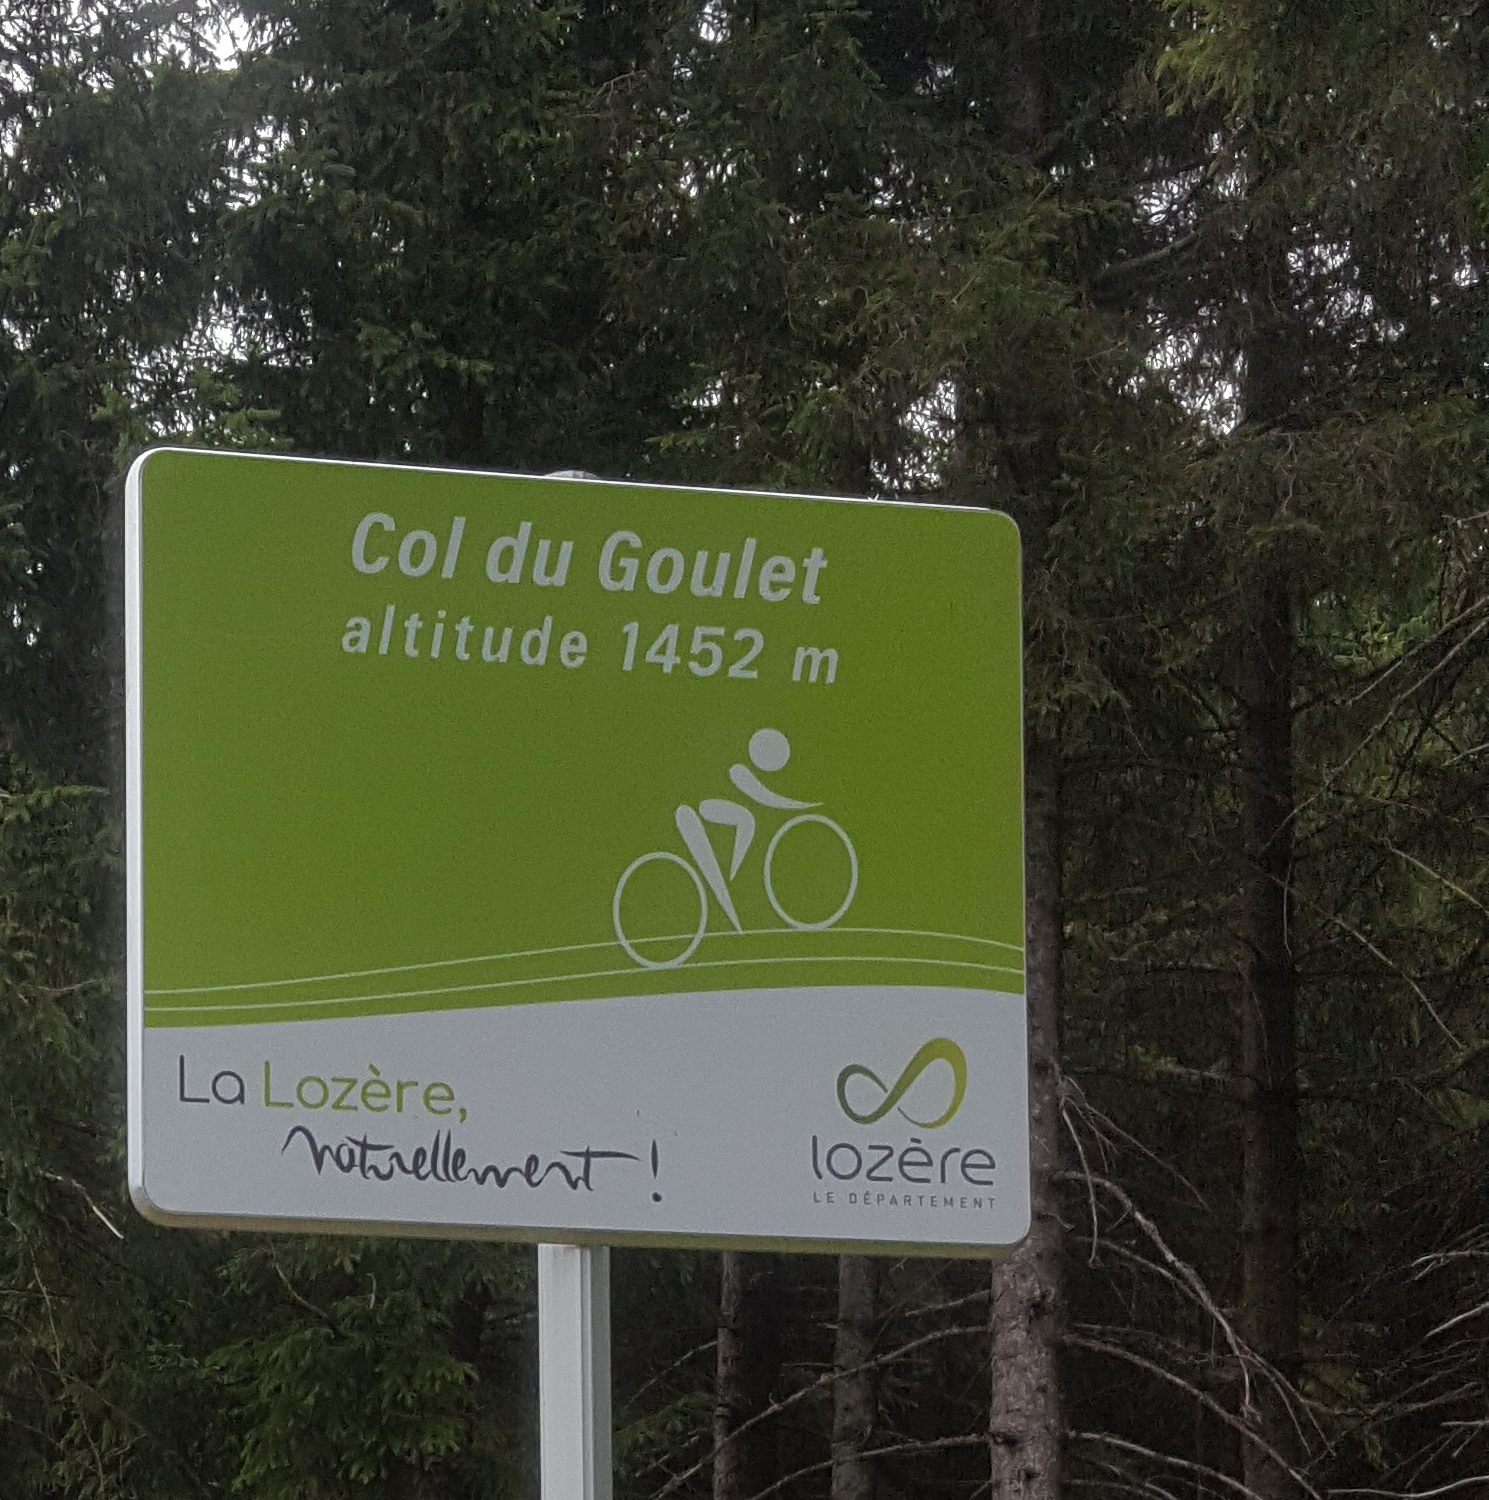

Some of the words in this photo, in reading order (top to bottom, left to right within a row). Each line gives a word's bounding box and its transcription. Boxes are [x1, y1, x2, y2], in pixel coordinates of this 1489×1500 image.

[351, 511, 467, 579] Col
[485, 520, 574, 588] du
[598, 530, 828, 605] Goulet
[341, 605, 588, 668] altitude
[622, 621, 762, 680] 1452
[792, 643, 839, 684] m
[179, 1054, 245, 1105] La
[263, 1060, 468, 1123] Lozère,
[811, 1134, 996, 1186] lozère
[813, 1191, 835, 1204] LE
[848, 1191, 996, 1209] DÉPARTEMENT
